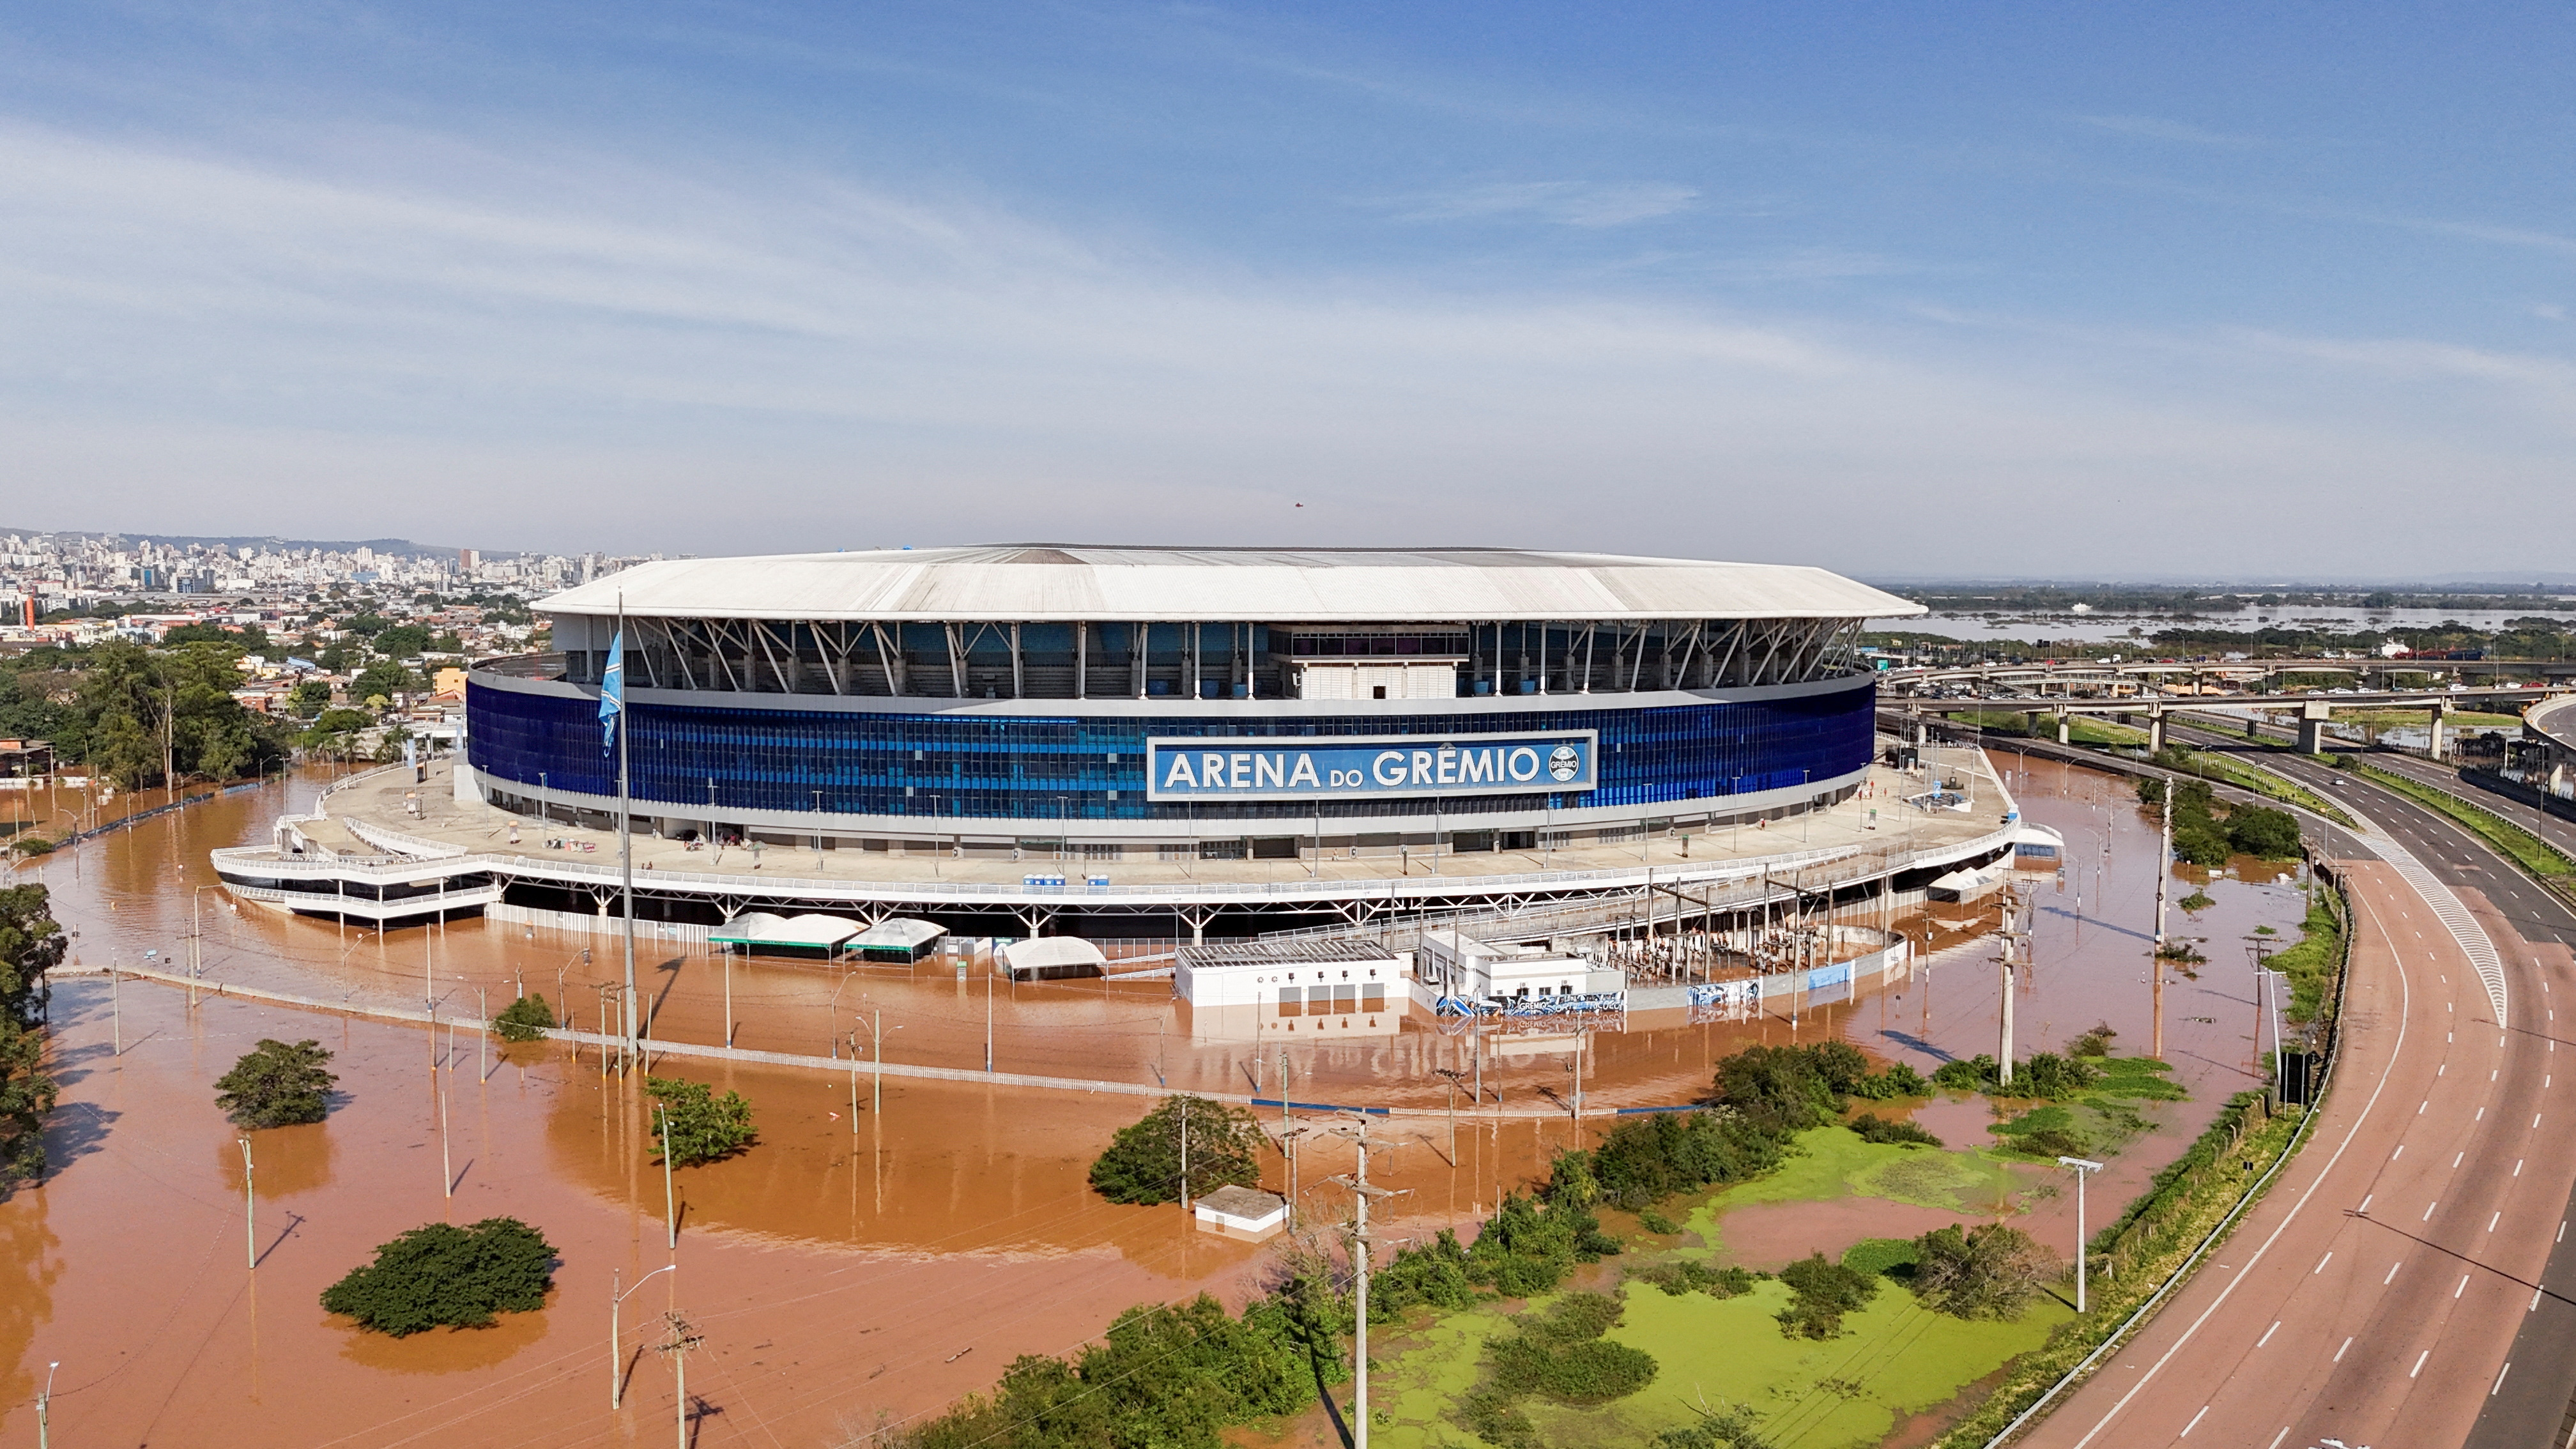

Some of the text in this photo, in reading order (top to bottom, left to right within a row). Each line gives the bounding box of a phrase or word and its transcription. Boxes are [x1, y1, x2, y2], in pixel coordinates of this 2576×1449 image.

[1163, 742, 1540, 788] ARENA DO GRÊMIO
